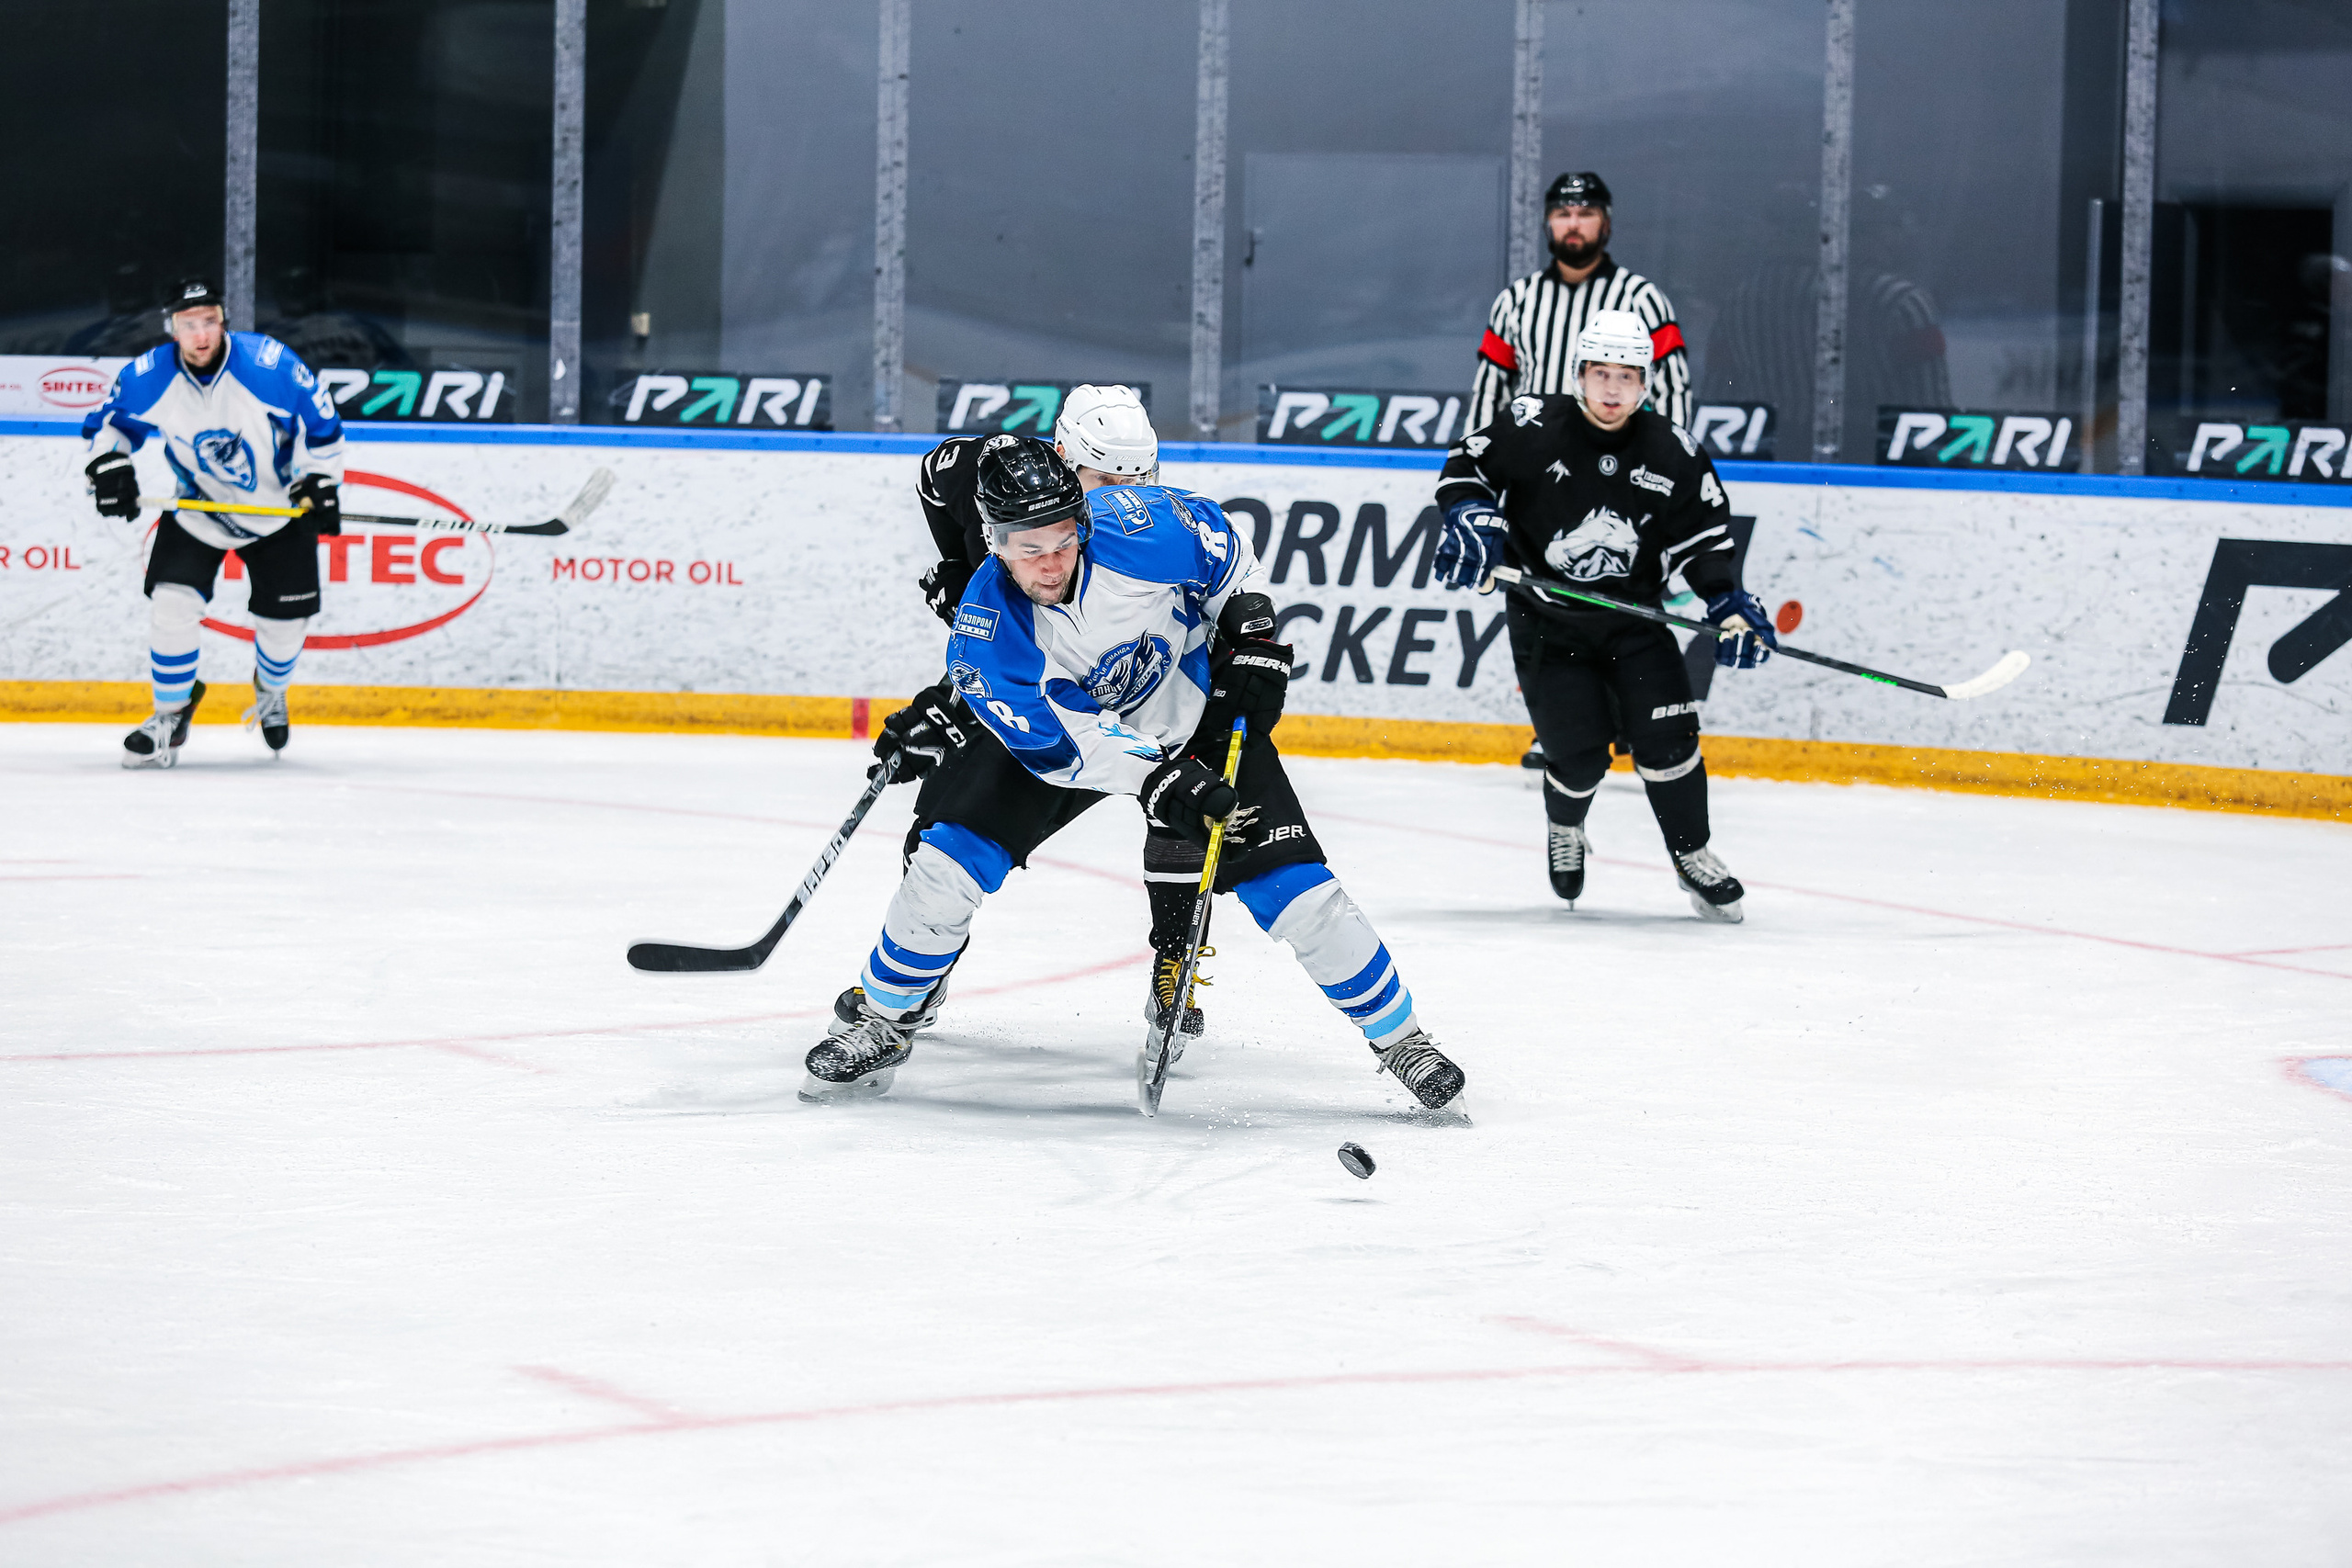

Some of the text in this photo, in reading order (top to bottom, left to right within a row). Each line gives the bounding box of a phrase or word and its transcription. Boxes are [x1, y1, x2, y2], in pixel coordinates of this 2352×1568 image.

[43, 382, 107, 393] SINTEC
[624, 375, 822, 425] PARI
[1267, 392, 1461, 444] PARI
[1691, 405, 1768, 454] RI
[1887, 412, 2072, 467] PARI
[1028, 497, 1060, 512] BAUER
[1700, 471, 1724, 508] 4
[24, 546, 82, 570] OIL
[1221, 498, 1462, 591] ORM
[553, 558, 743, 585] MOTOR OIL
[926, 704, 967, 749] CC
[1192, 899, 1203, 926] BAUER
